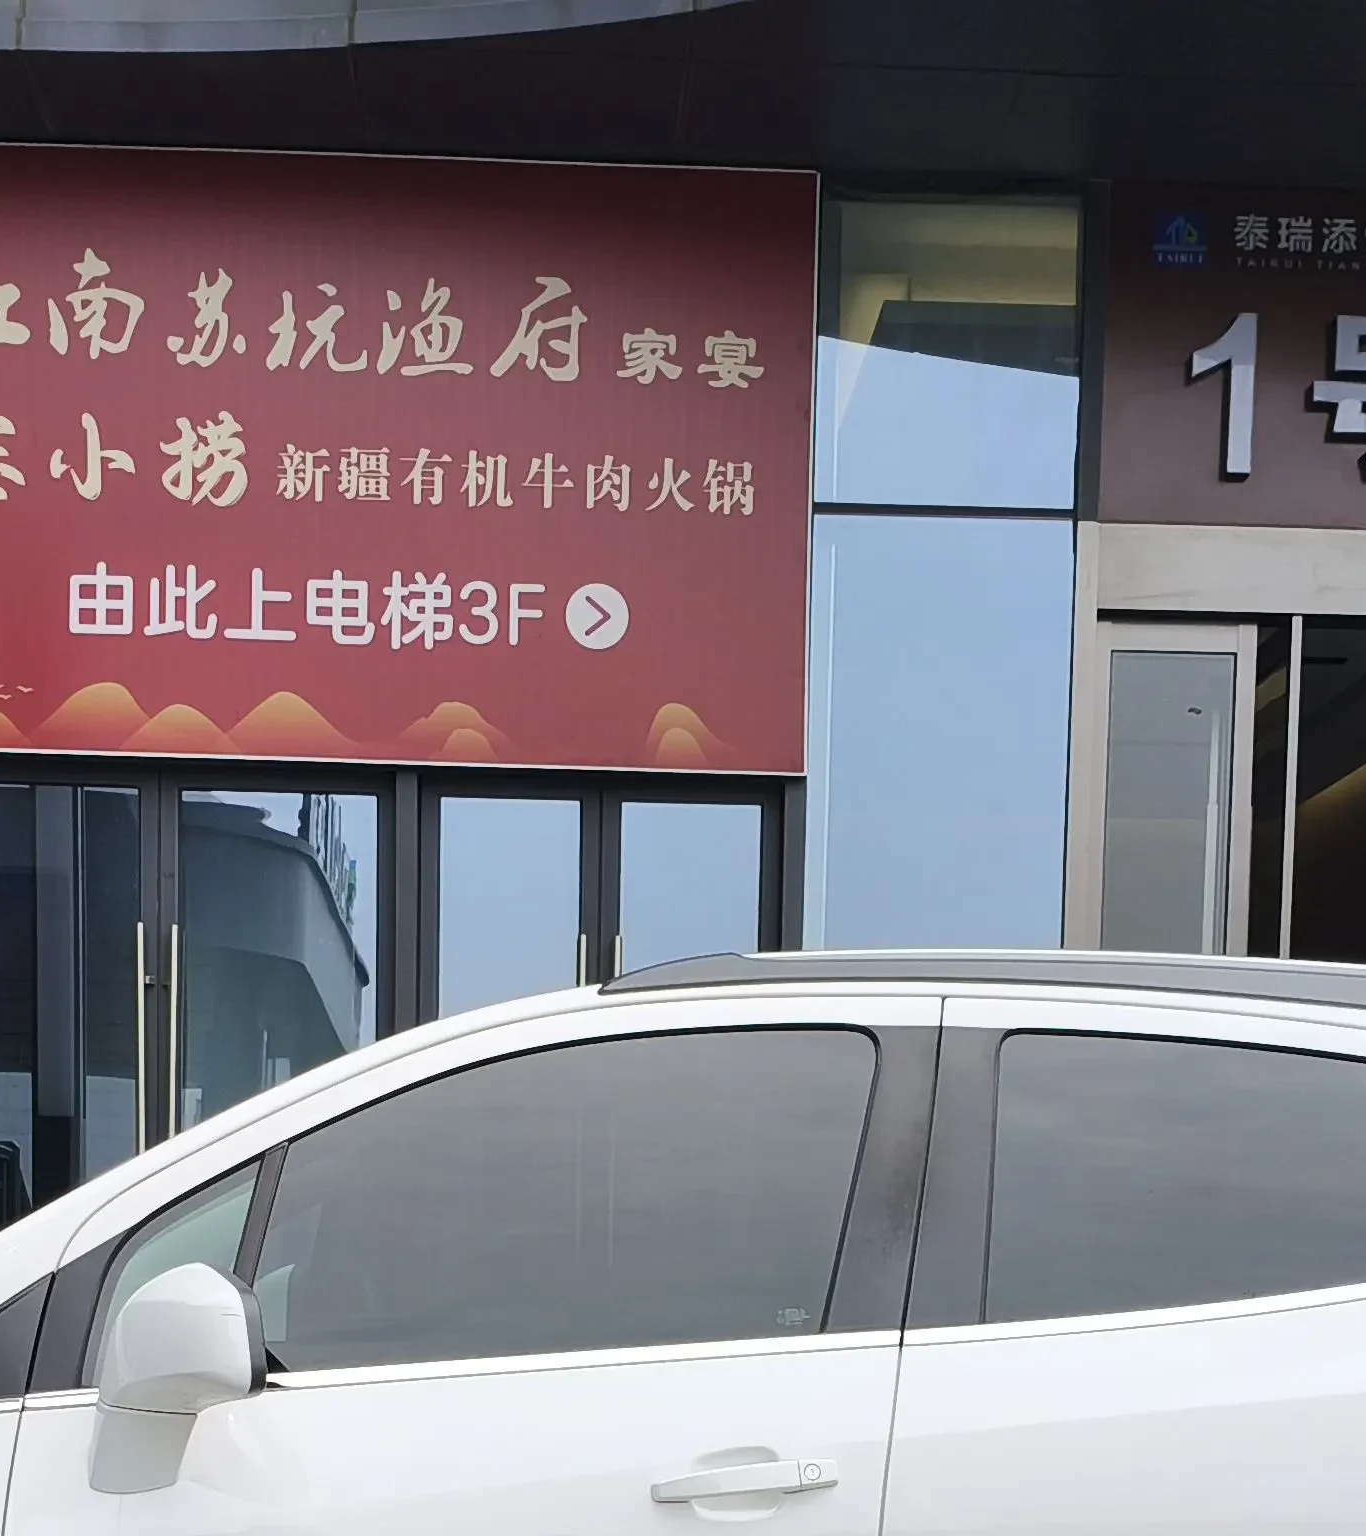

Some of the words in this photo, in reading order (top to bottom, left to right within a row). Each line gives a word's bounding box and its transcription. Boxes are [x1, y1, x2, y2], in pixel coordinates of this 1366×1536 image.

[1236, 256, 1303, 271] TAIRUI
[616, 327, 765, 389] 家宴
[274, 443, 756, 517] 新疆有机牛肉火锅
[68, 561, 546, 650] 由此上电梯3F
